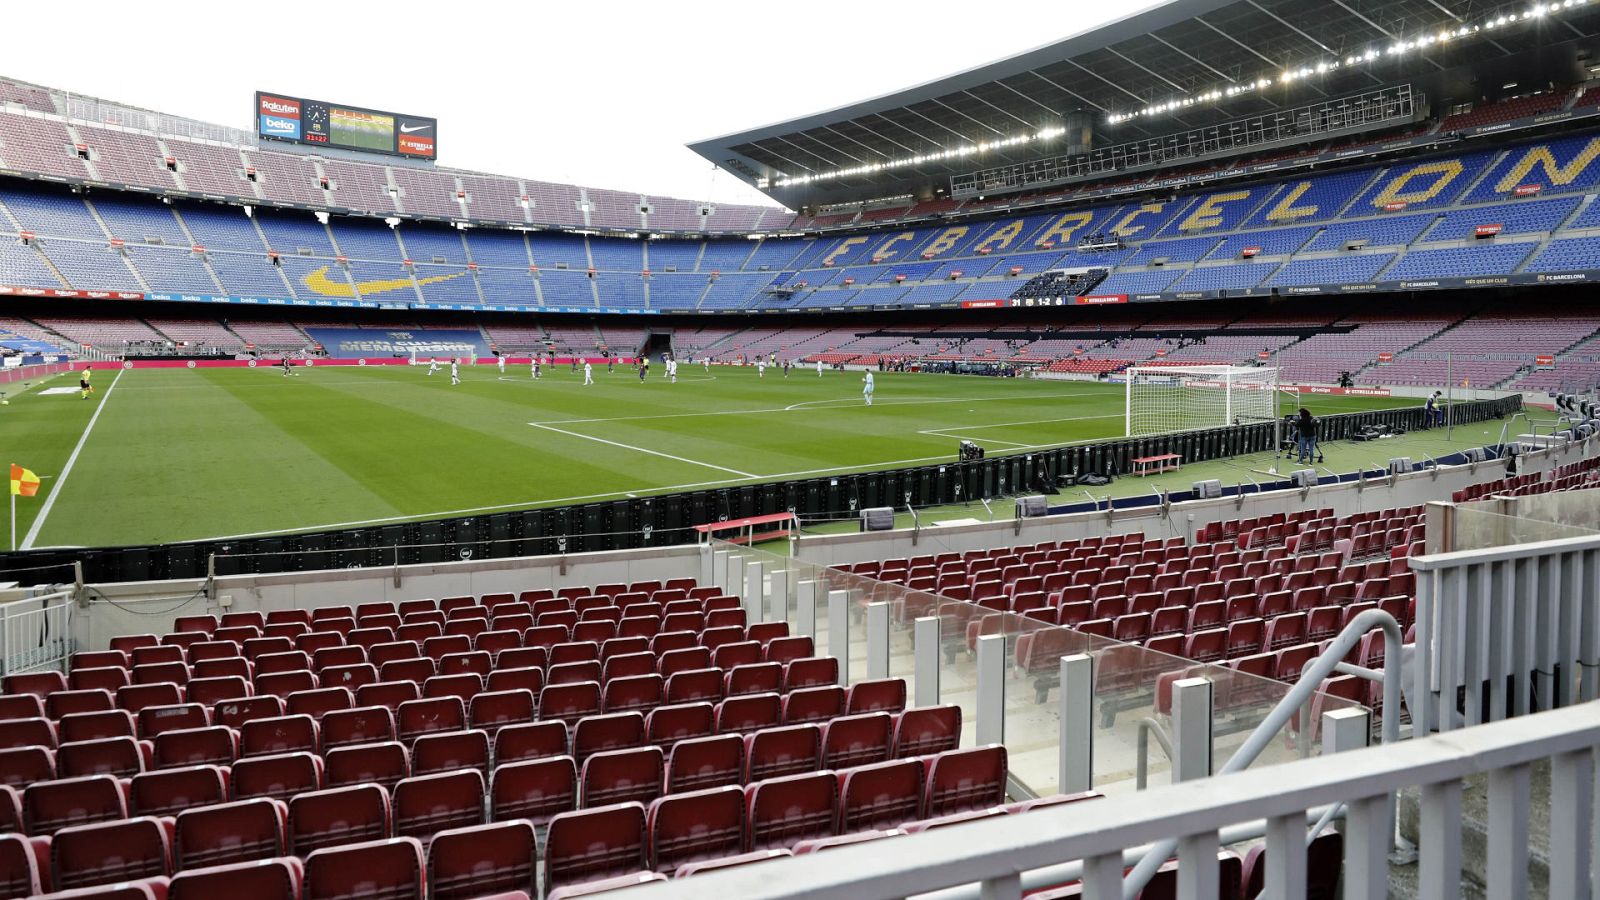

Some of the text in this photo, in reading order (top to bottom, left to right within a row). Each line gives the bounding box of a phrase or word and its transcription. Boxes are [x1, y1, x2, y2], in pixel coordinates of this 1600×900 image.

[262, 100, 299, 113] Rakuten
[266, 117, 295, 130] beko
[1553, 273, 1585, 281] BARCELONA
[1011, 298, 1051, 307] 31 1-2
